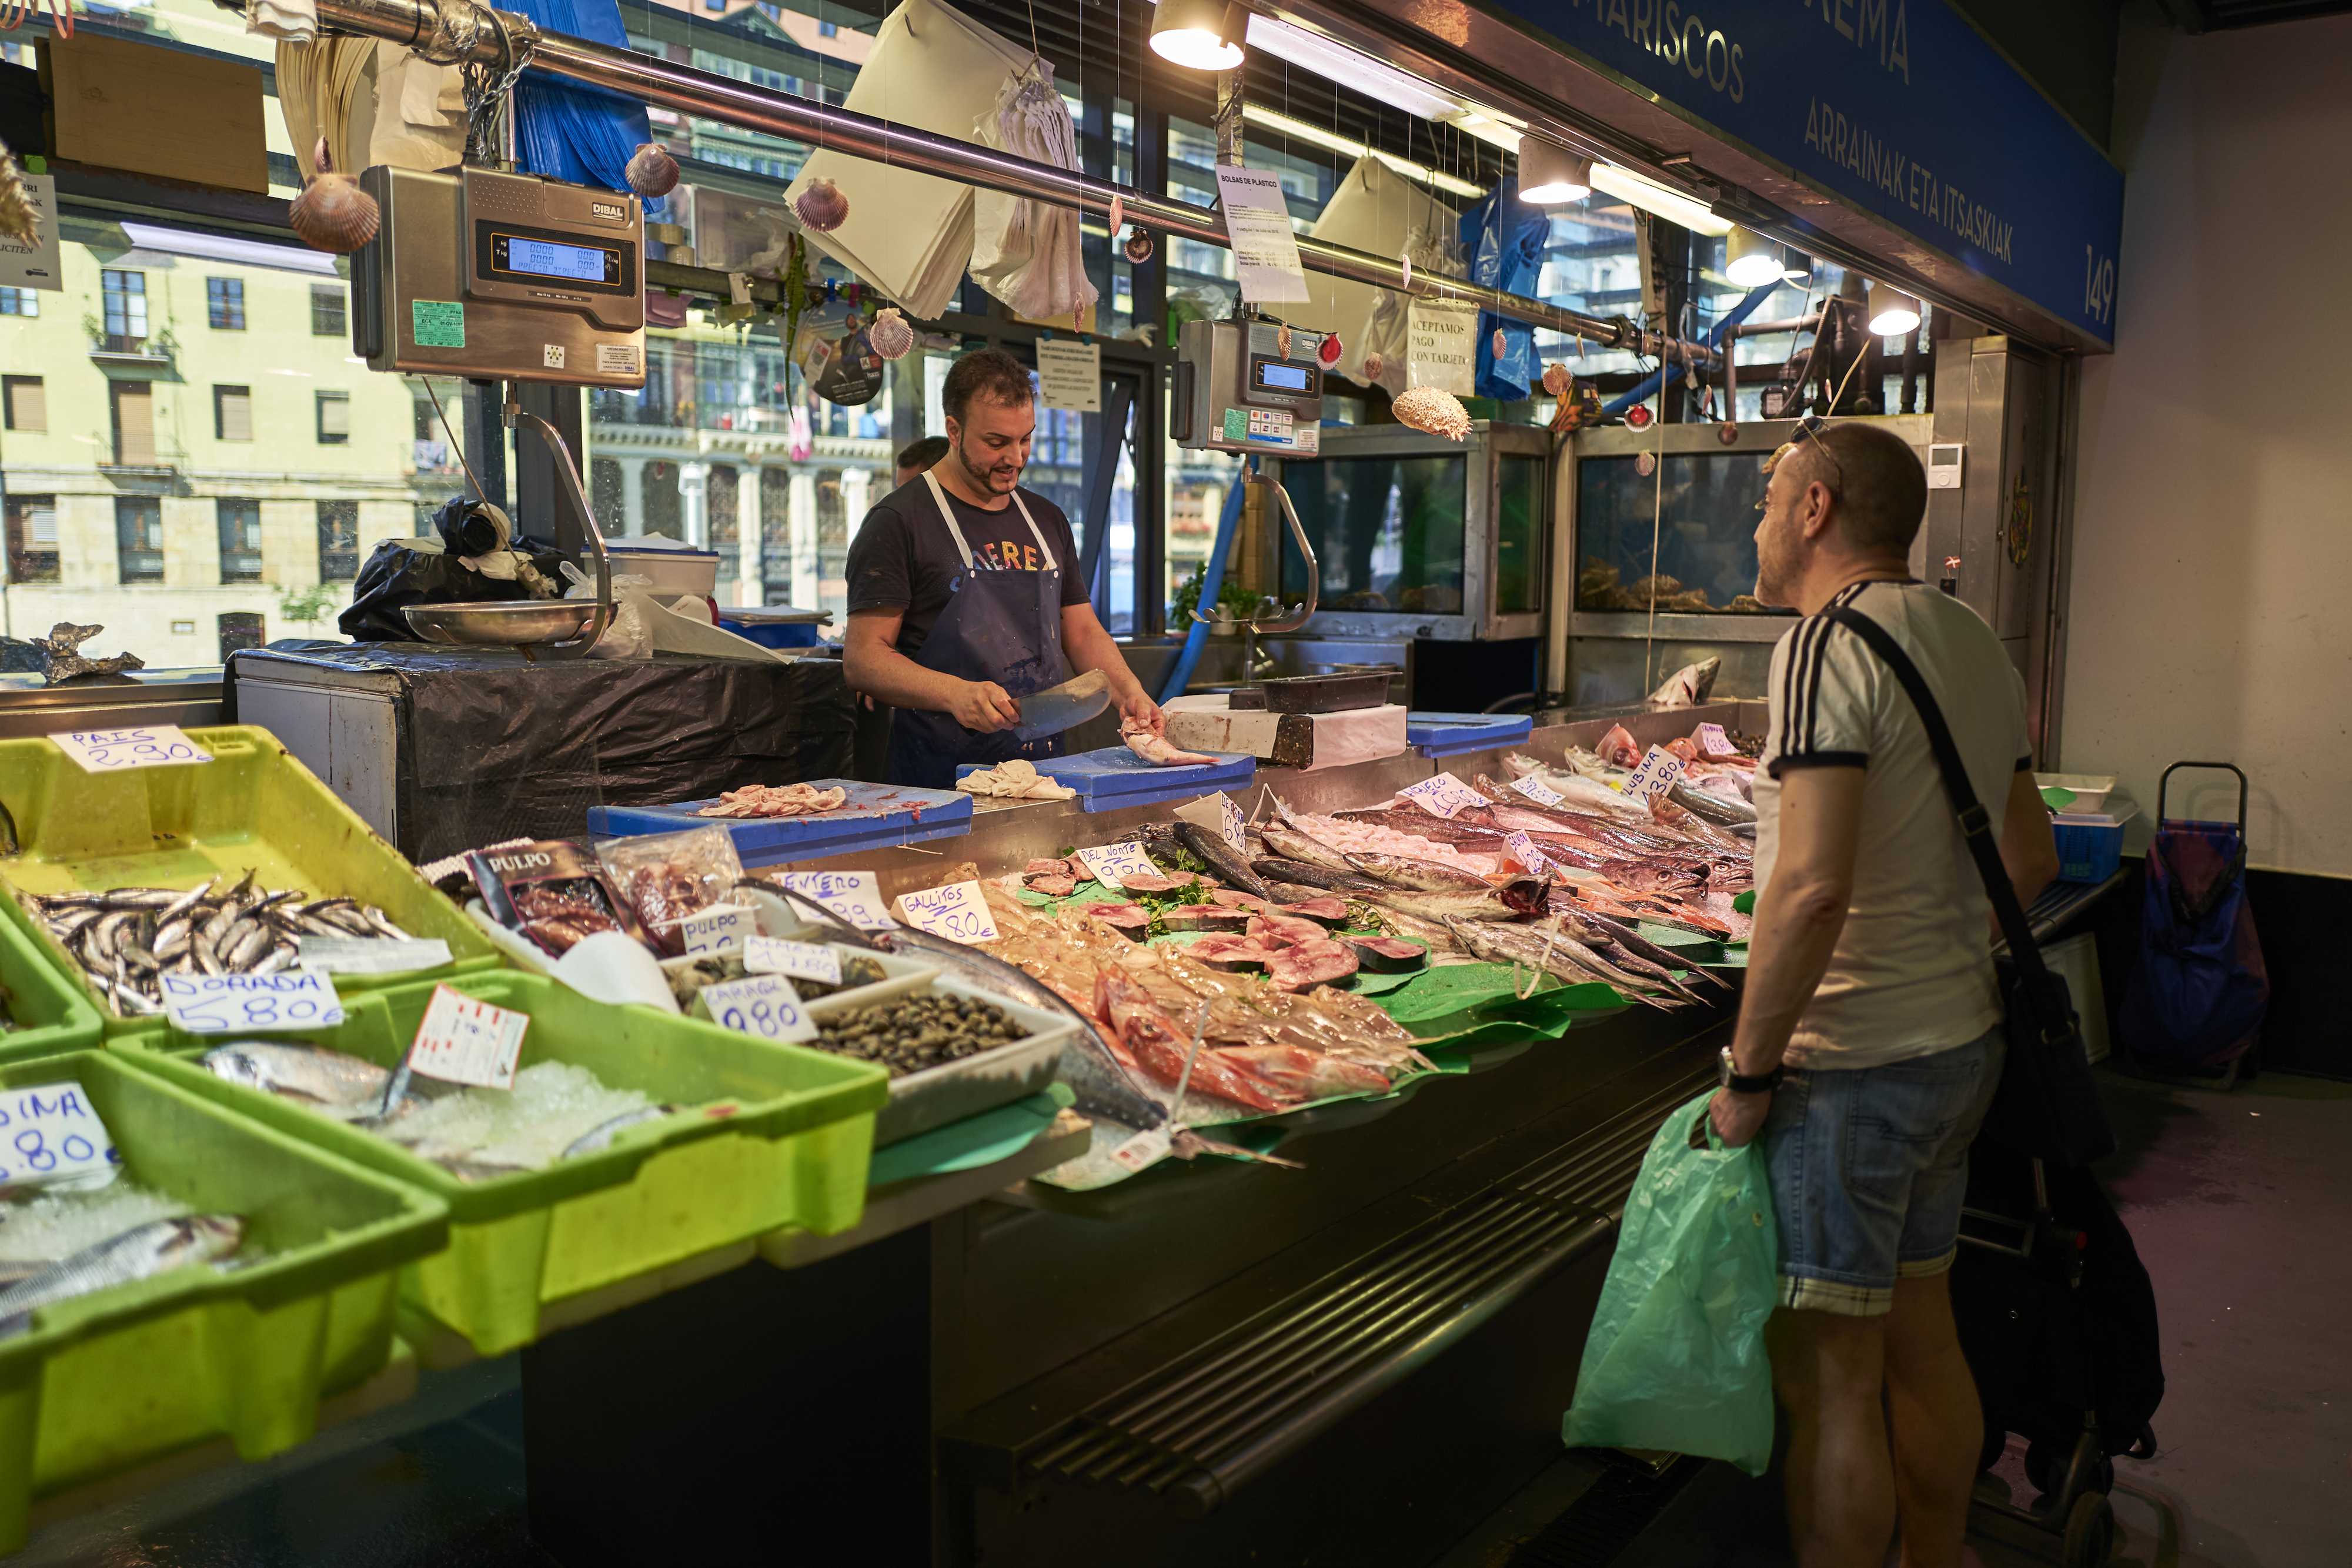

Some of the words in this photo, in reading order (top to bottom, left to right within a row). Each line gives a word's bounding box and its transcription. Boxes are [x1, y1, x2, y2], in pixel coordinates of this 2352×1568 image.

[1573, 0, 1743, 103] ARISCOS
[1221, 175, 1243, 184] BOLSAS
[1252, 177, 1277, 188] PLÁSTICO
[1804, 95, 1906, 202] ARRAINAK
[1910, 162, 1939, 222] ETA
[1944, 183, 2013, 265] ITSASKIAK
[593, 203, 623, 217] DIBAL
[2085, 243, 2113, 325] 149
[1412, 320, 1465, 335] ACEPTAMOS
[1302, 339, 1316, 348] DIBAL
[1412, 335, 1434, 347] PAGO
[1412, 351, 1429, 362] CON
[1430, 353, 1466, 366] TARJETA
[72, 730, 156, 746] PAIS
[1623, 752, 1660, 795] LUBINA
[1081, 850, 1101, 862] DEL
[1107, 842, 1137, 857] NORTE
[487, 852, 552, 873] PULPO
[785, 871, 860, 891] ENTERO
[685, 914, 737, 940] PULPO
[165, 974, 322, 995] DORADA
